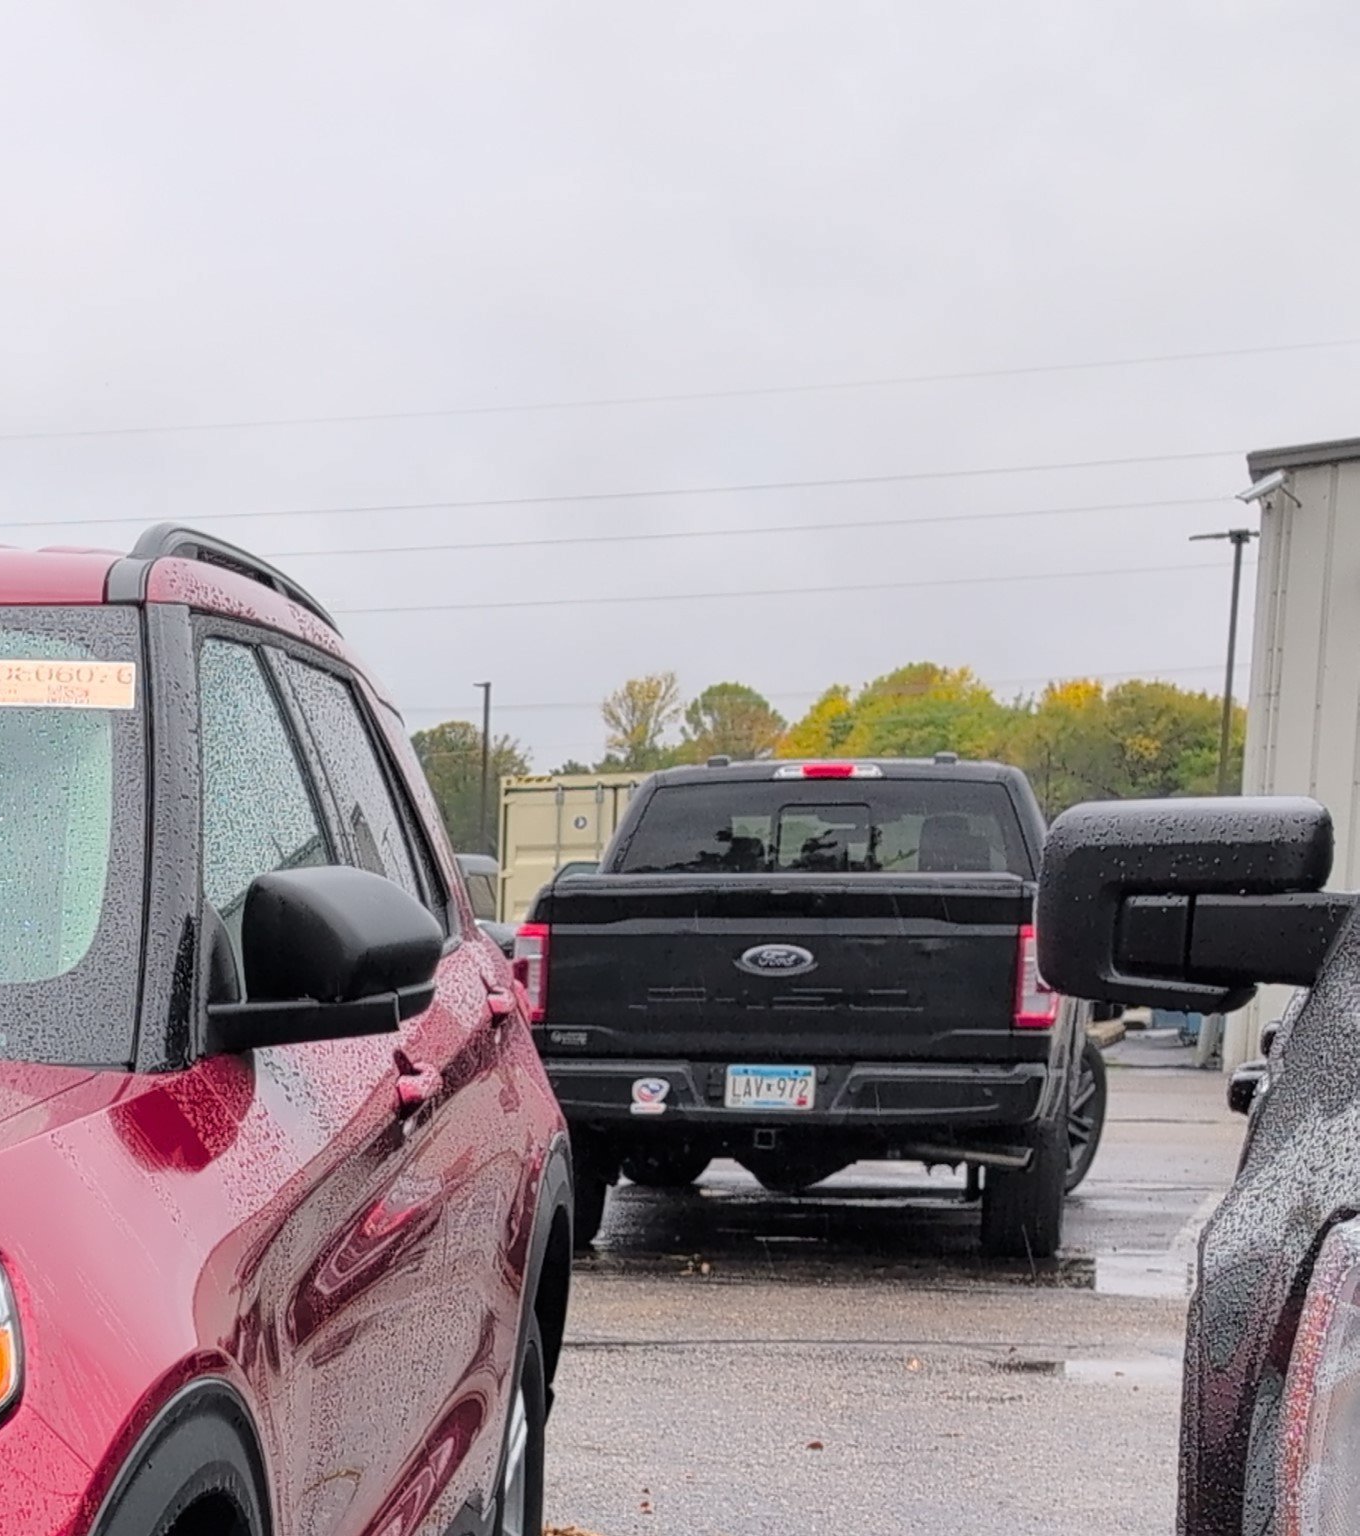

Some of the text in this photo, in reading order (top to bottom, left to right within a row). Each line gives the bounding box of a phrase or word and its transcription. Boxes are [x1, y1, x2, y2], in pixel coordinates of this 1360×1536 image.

[758, 950, 797, 967] Ford
[732, 1076, 809, 1098] LAV 972
